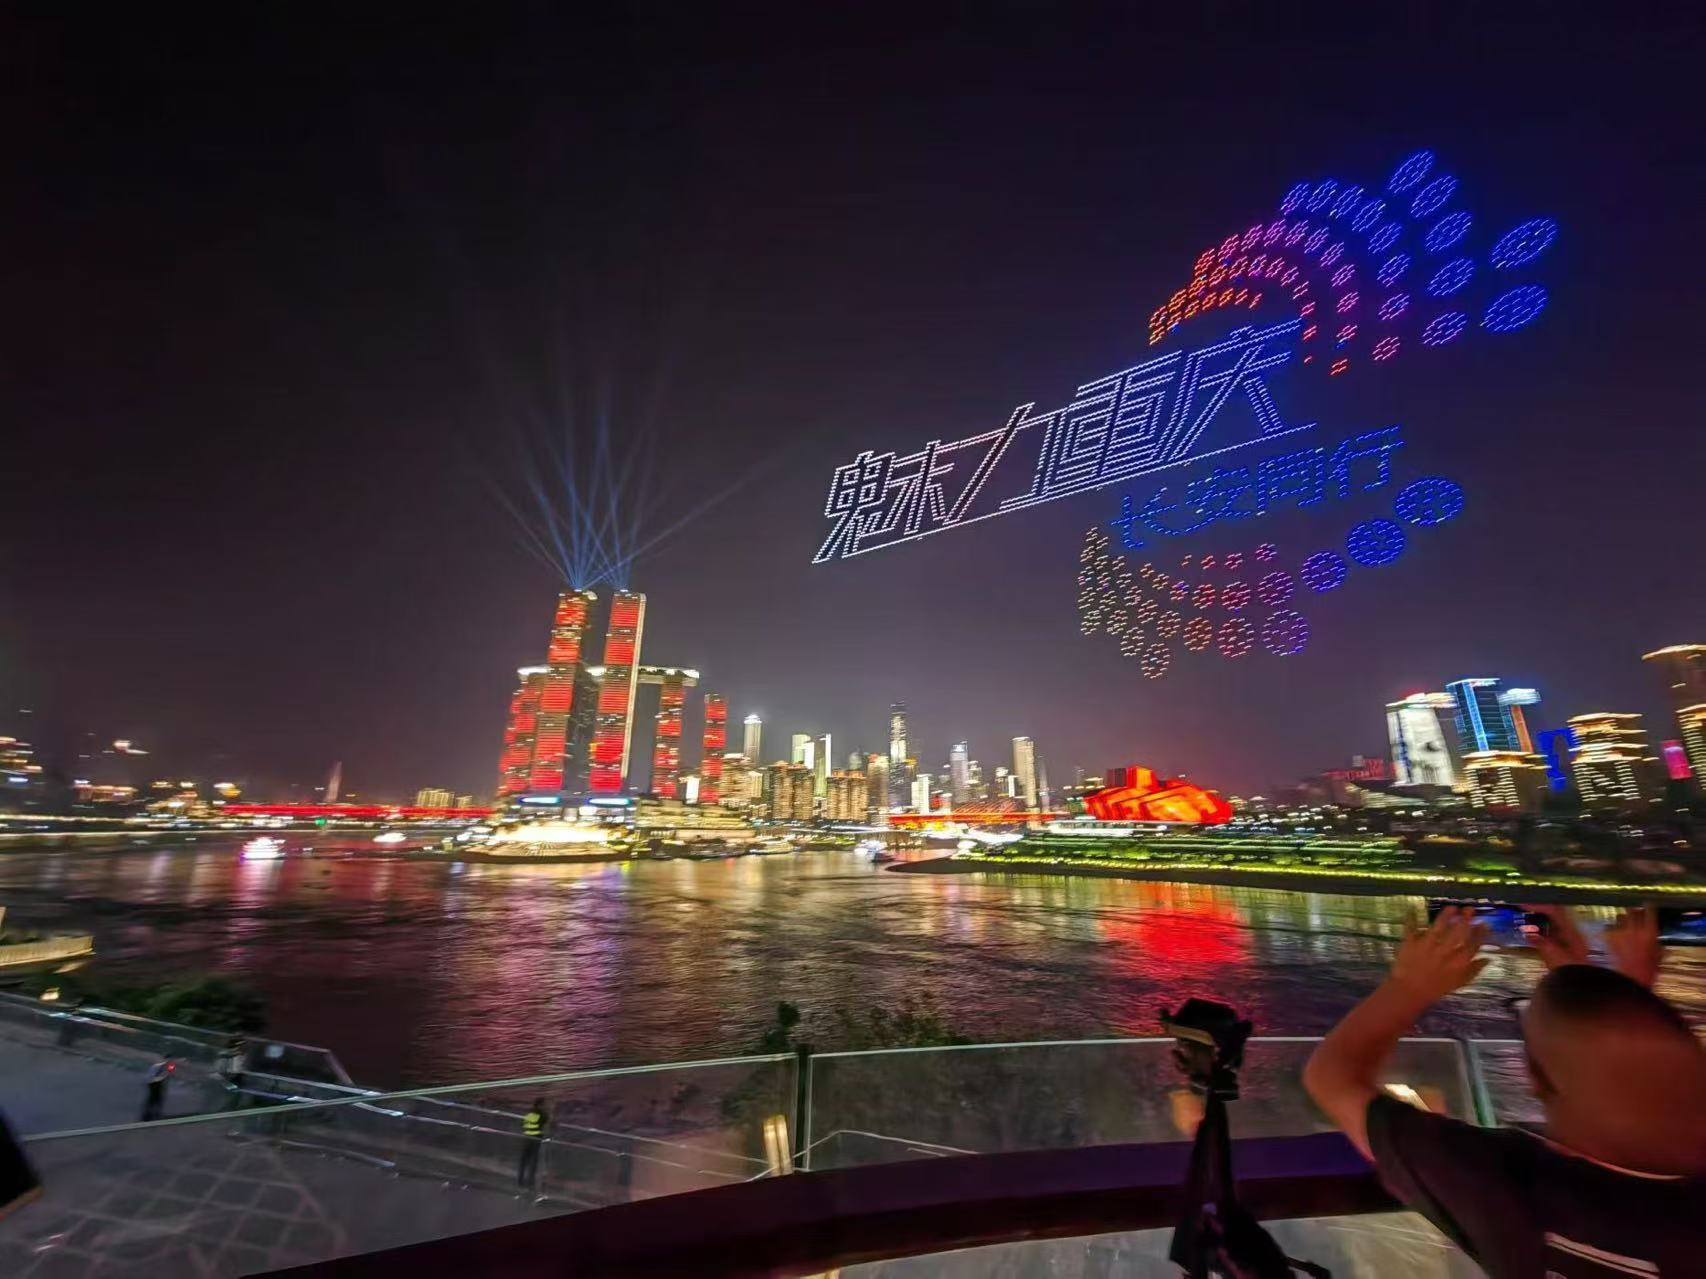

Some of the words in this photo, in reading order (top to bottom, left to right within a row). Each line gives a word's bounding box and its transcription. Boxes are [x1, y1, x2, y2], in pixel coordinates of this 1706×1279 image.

[811, 317, 1312, 565] 魅力重庆
[1110, 424, 1406, 549] 长安同行
